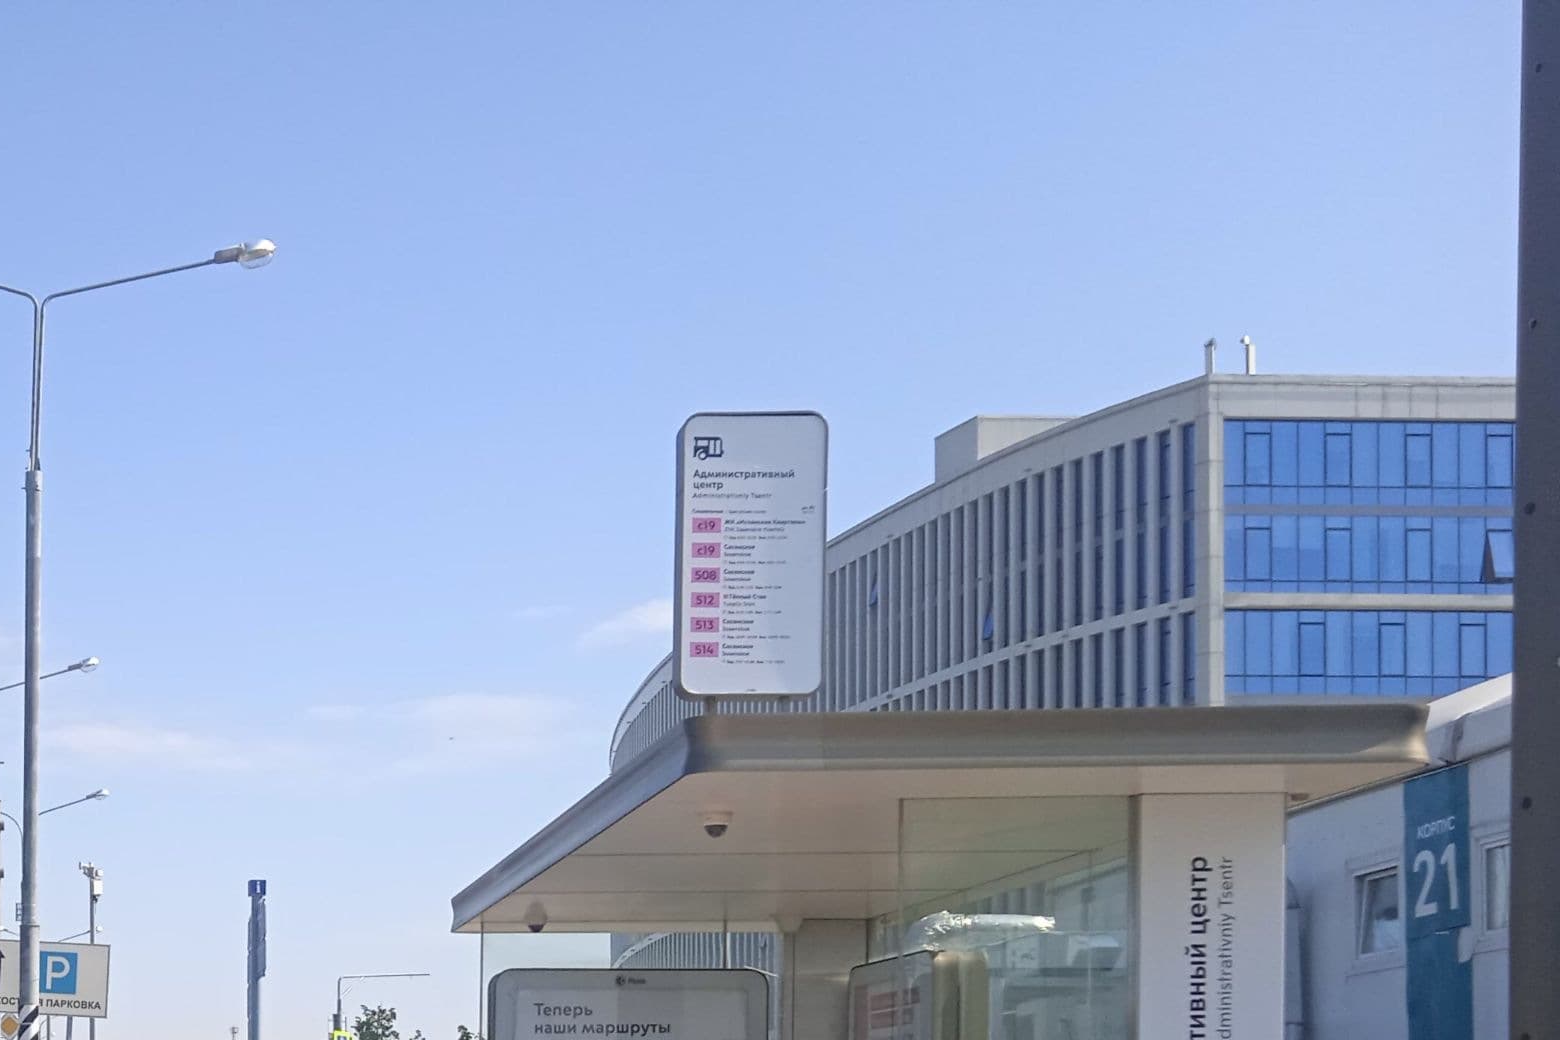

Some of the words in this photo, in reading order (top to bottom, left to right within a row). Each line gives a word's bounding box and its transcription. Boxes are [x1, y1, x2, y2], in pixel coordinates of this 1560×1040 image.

[692, 469, 795, 480] Административный
[693, 482, 724, 490] центр
[696, 595, 715, 605] 512
[695, 620, 714, 630] 513
[695, 645, 714, 655] 514
[1217, 856, 1233, 907] Tsentr
[1413, 842, 1460, 918] 21
[1191, 855, 1213, 935] центр
[46, 955, 71, 990] P
[46, 999, 101, 1010] ПАРКОВКА
[534, 1003, 593, 1017] Теперь
[534, 1023, 577, 1034] наши
[582, 1022, 671, 1037] маршруты
